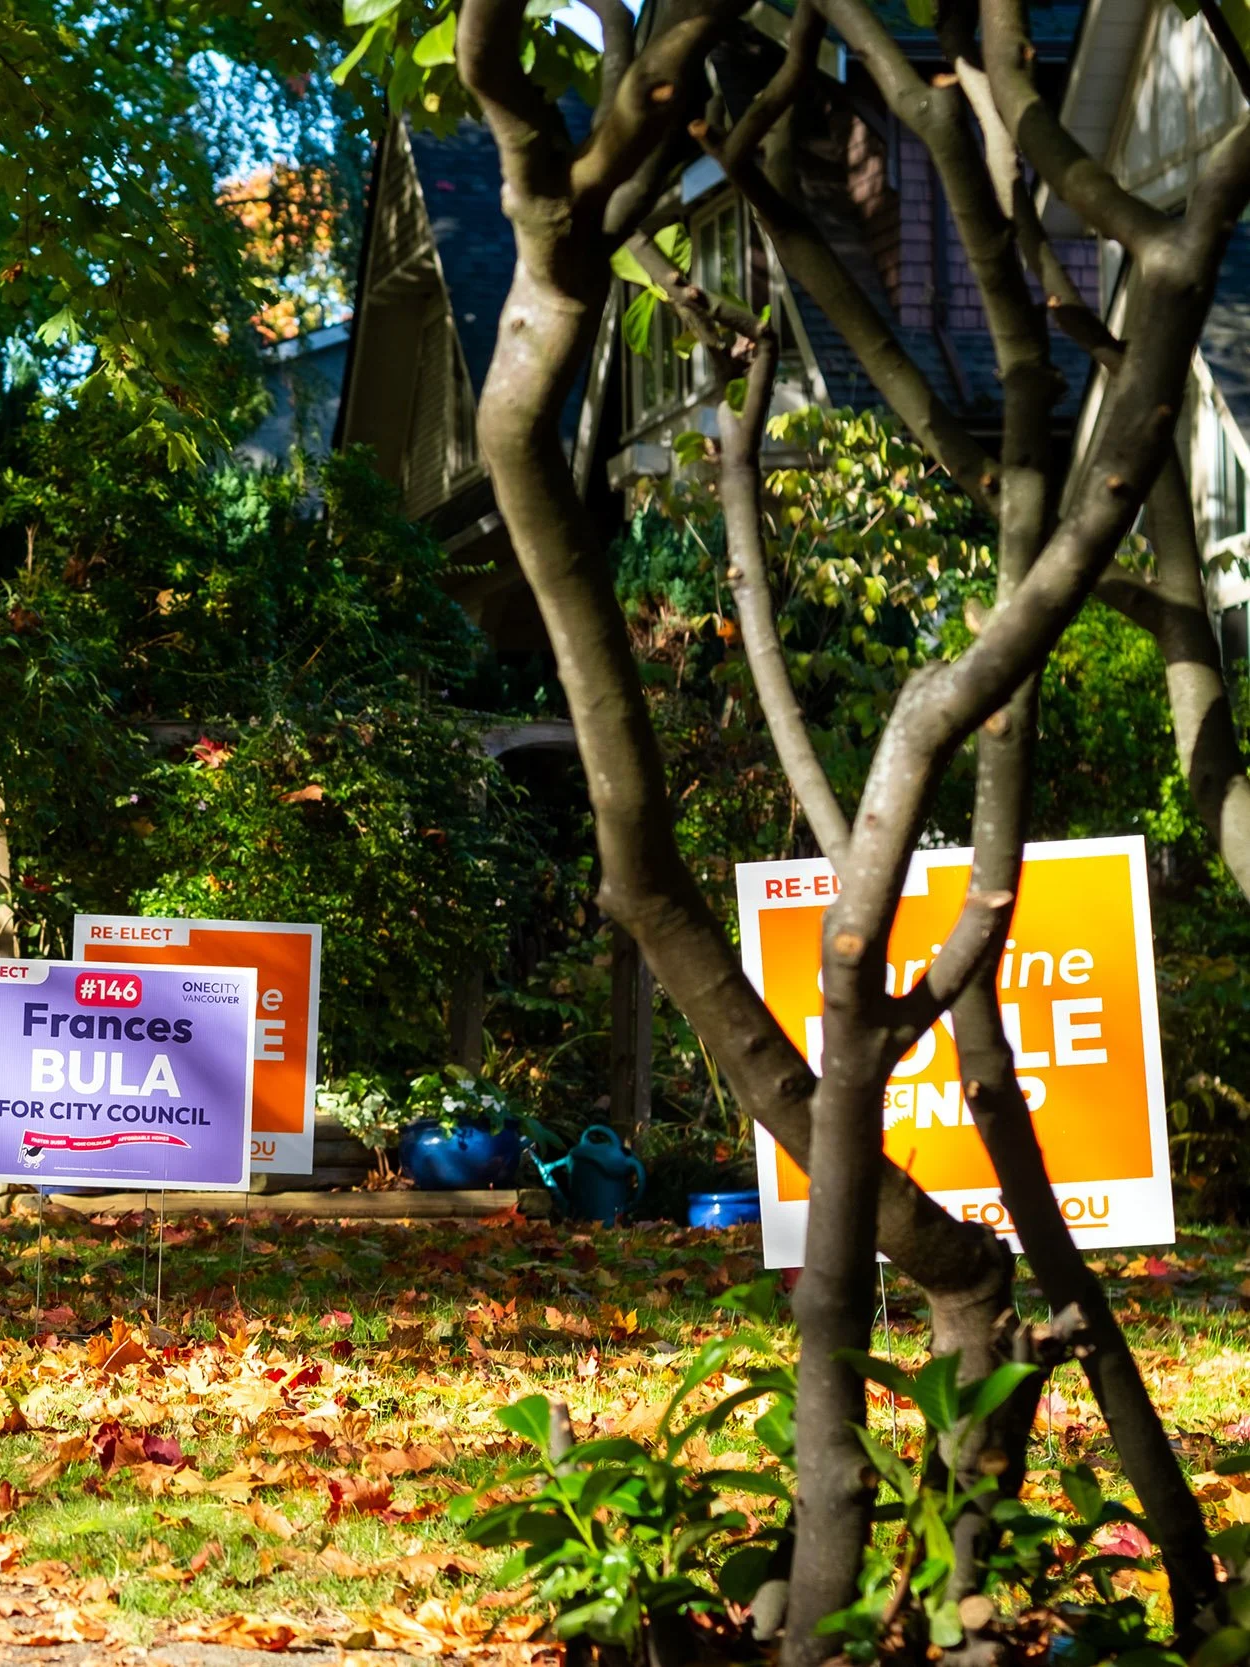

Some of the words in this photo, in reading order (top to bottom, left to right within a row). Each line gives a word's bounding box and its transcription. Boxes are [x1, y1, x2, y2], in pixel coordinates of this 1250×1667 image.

[765, 875, 842, 899] RE-EL
[90, 926, 173, 942] RE-ELECT
[79, 978, 138, 1002] #146
[182, 981, 240, 994] ONECITY
[182, 994, 239, 1004] VANCOUVER
[23, 1002, 193, 1044] Frances
[30, 1048, 181, 1098] BULA
[50, 1101, 103, 1121] CITY
[107, 1104, 210, 1126] COUNCIL
[962, 1203, 1014, 1226] FO
[1055, 1195, 1109, 1221] OU
